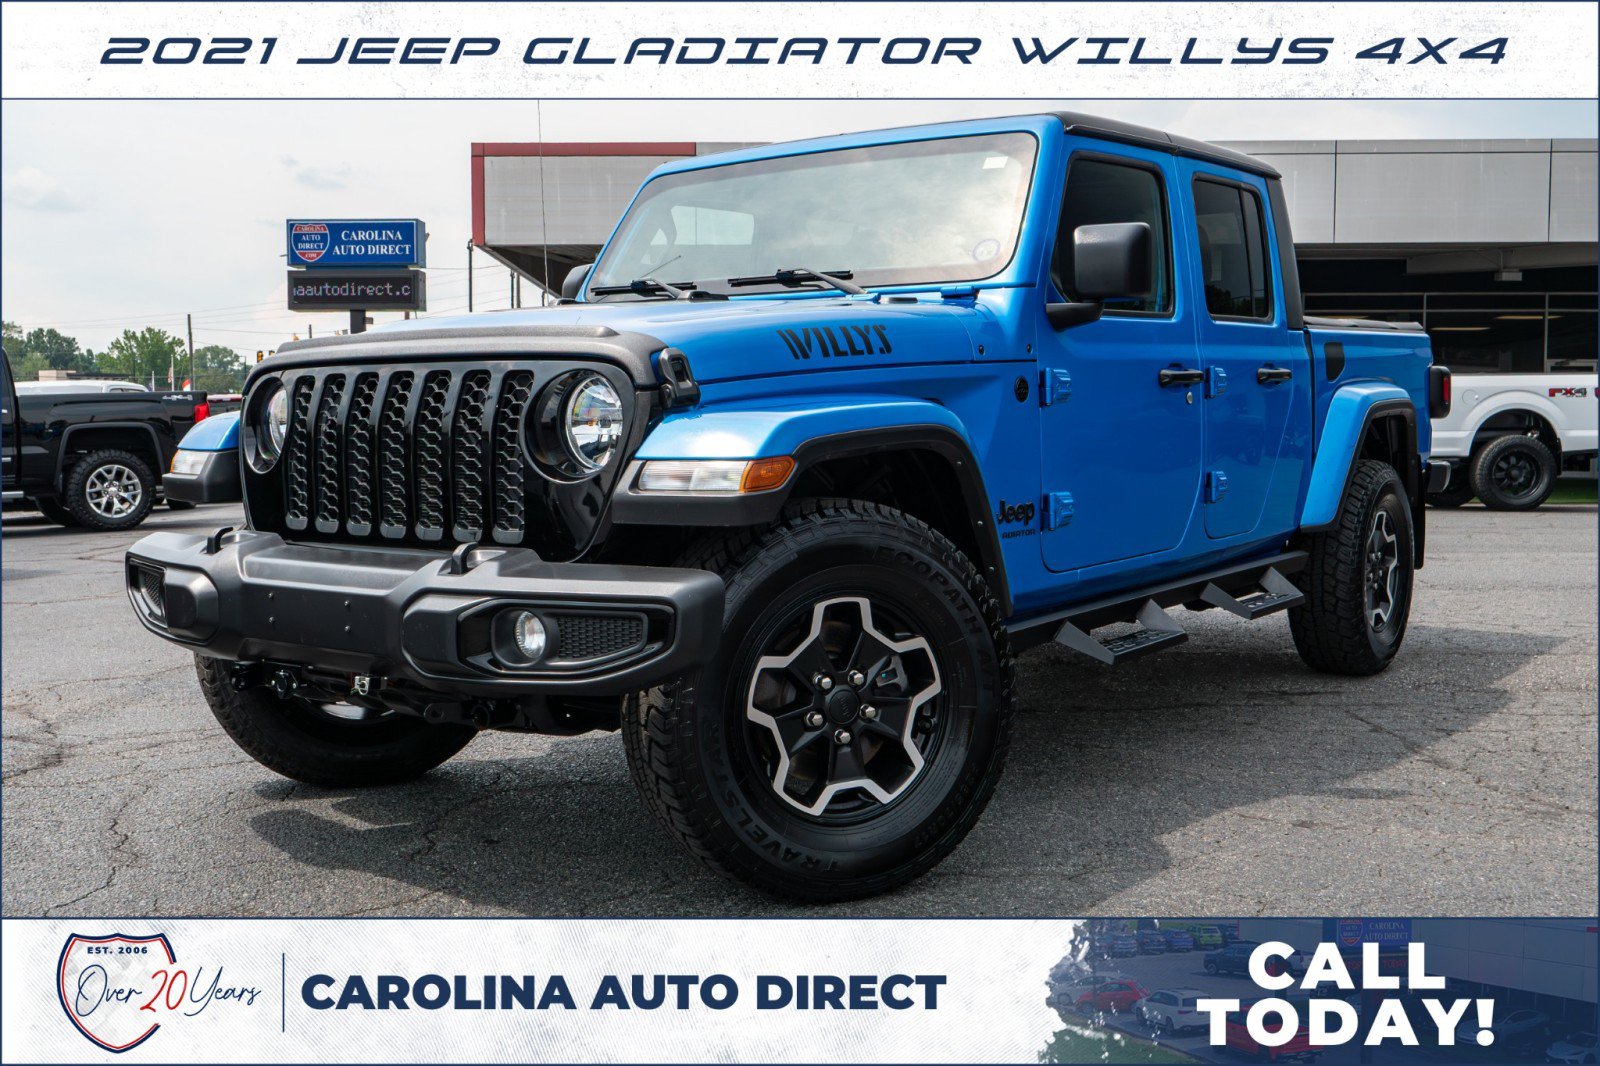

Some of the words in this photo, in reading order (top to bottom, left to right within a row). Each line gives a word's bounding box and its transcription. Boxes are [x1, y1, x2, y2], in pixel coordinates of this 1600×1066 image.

[341, 230, 402, 242] CAROLINA
[298, 242, 324, 250] DIRECT
[332, 244, 365, 255] AUTO
[367, 244, 411, 255] DIRECT
[776, 324, 892, 360] WILLYS
[1549, 387, 1587, 398] FX4
[995, 498, 1035, 526] Jeep
[1001, 528, 1036, 539] ADIATOR
[874, 545, 982, 635] ECOPATH
[701, 720, 839, 872] TRAVELSTAR
